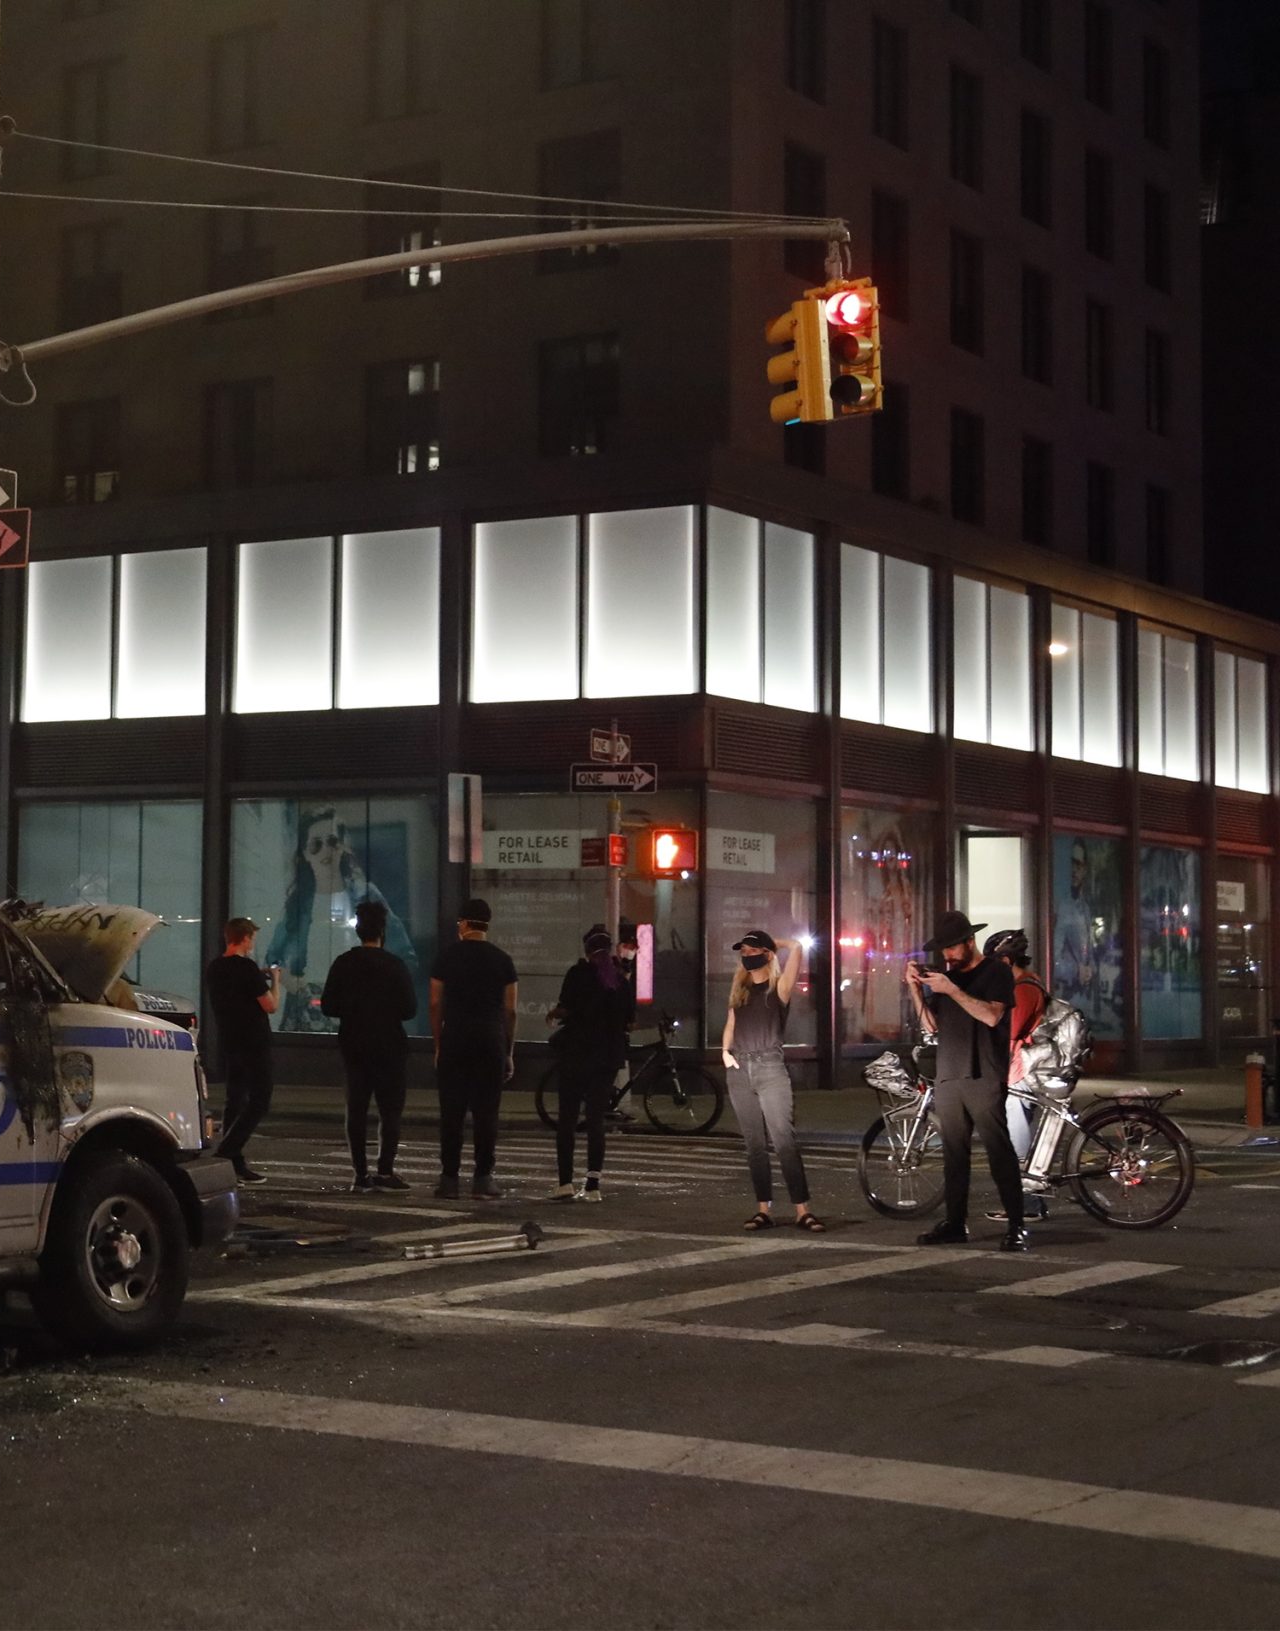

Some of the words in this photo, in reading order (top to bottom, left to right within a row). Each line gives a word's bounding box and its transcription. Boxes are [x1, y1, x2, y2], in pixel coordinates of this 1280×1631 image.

[578, 773, 604, 785] ONE
[617, 773, 645, 785] WAY
[498, 836, 523, 849] FOR
[527, 836, 569, 849] LEASE
[722, 836, 737, 849] FOR
[739, 837, 761, 851] LEASE
[498, 852, 543, 864] RETAIL
[722, 852, 748, 866] RETAIL
[142, 1000, 178, 1012] POLICE
[126, 1027, 176, 1050] POLICE
